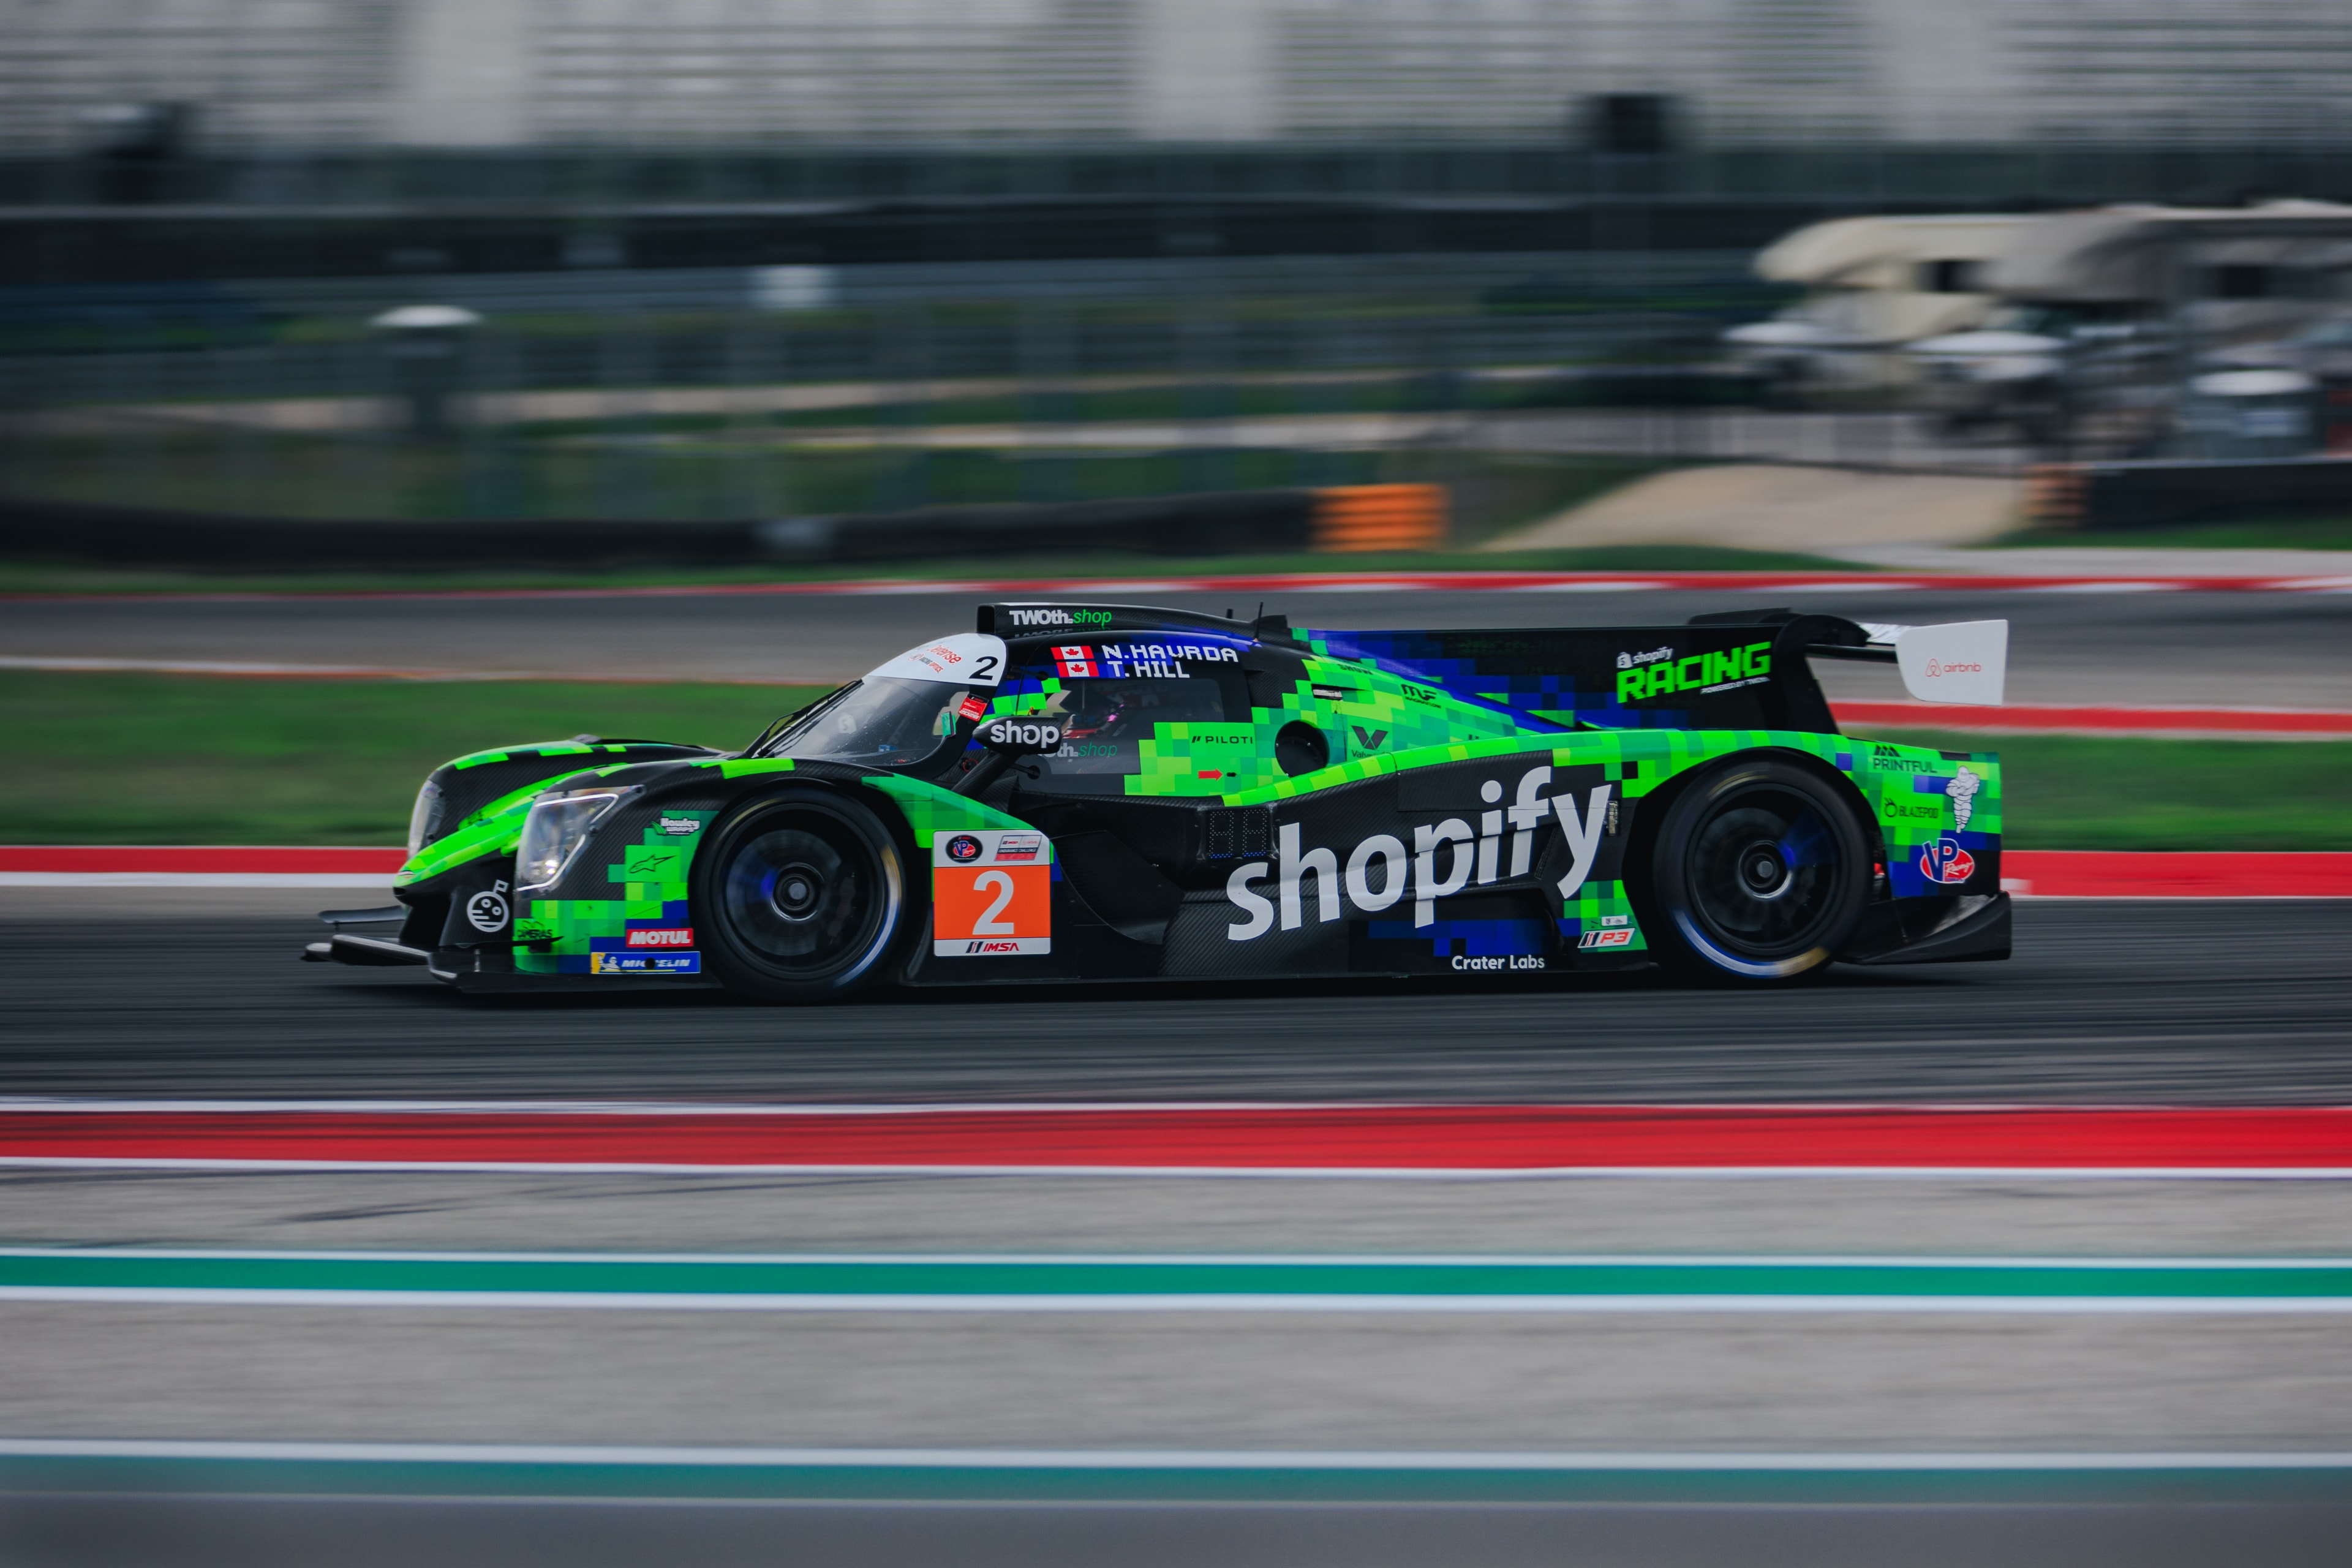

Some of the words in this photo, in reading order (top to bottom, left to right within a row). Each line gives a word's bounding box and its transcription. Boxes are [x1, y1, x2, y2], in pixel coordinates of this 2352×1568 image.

[1009, 609, 1112, 626] TWOth.shop
[1632, 646, 1673, 663] shopify
[968, 656, 998, 680] 2
[1617, 641, 1771, 703] RACING
[1943, 662, 1981, 672] airbnb
[990, 720, 1059, 748] shop
[1873, 758, 1937, 773] PRINTFUL
[1899, 805, 1939, 819] BLAZEPOD
[1226, 766, 1612, 941] shopify
[1923, 838, 1959, 883] VP
[972, 870, 1014, 935] 2
[629, 930, 691, 944] MOTUL
[1600, 931, 1629, 944] P3
[982, 943, 1020, 952] IMSA
[1452, 955, 1505, 970] Crater
[1510, 954, 1545, 969] Labs
